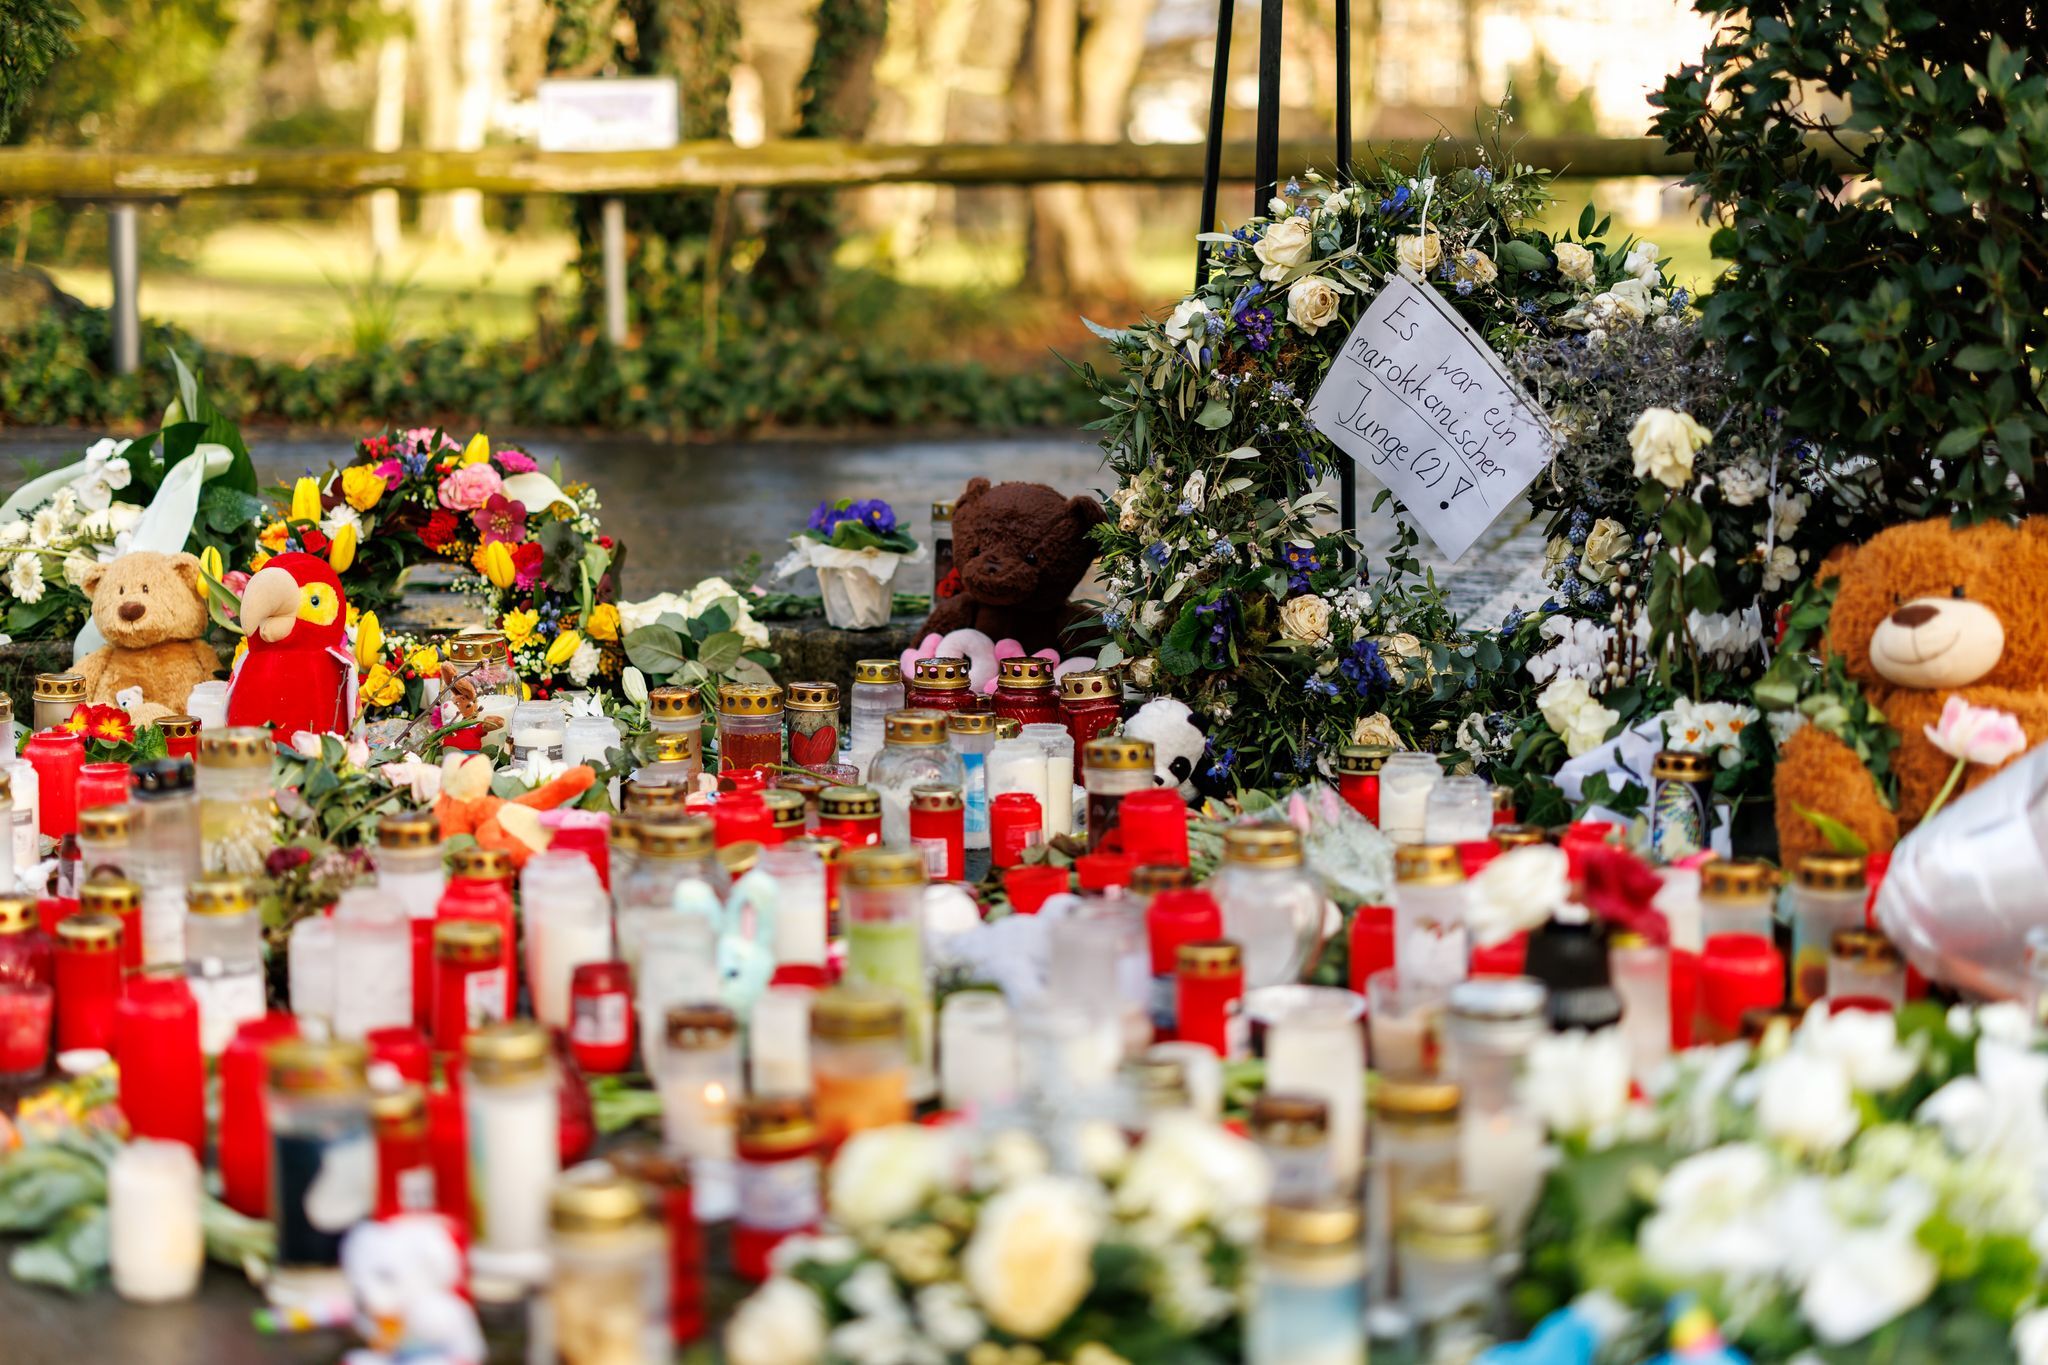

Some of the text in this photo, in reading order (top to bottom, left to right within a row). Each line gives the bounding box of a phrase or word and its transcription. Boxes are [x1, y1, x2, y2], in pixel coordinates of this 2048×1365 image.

[1337, 379, 1409, 465] Junge
[1350, 336, 1506, 478] marokkanischer
[1382, 296, 1517, 446] Es war ein
